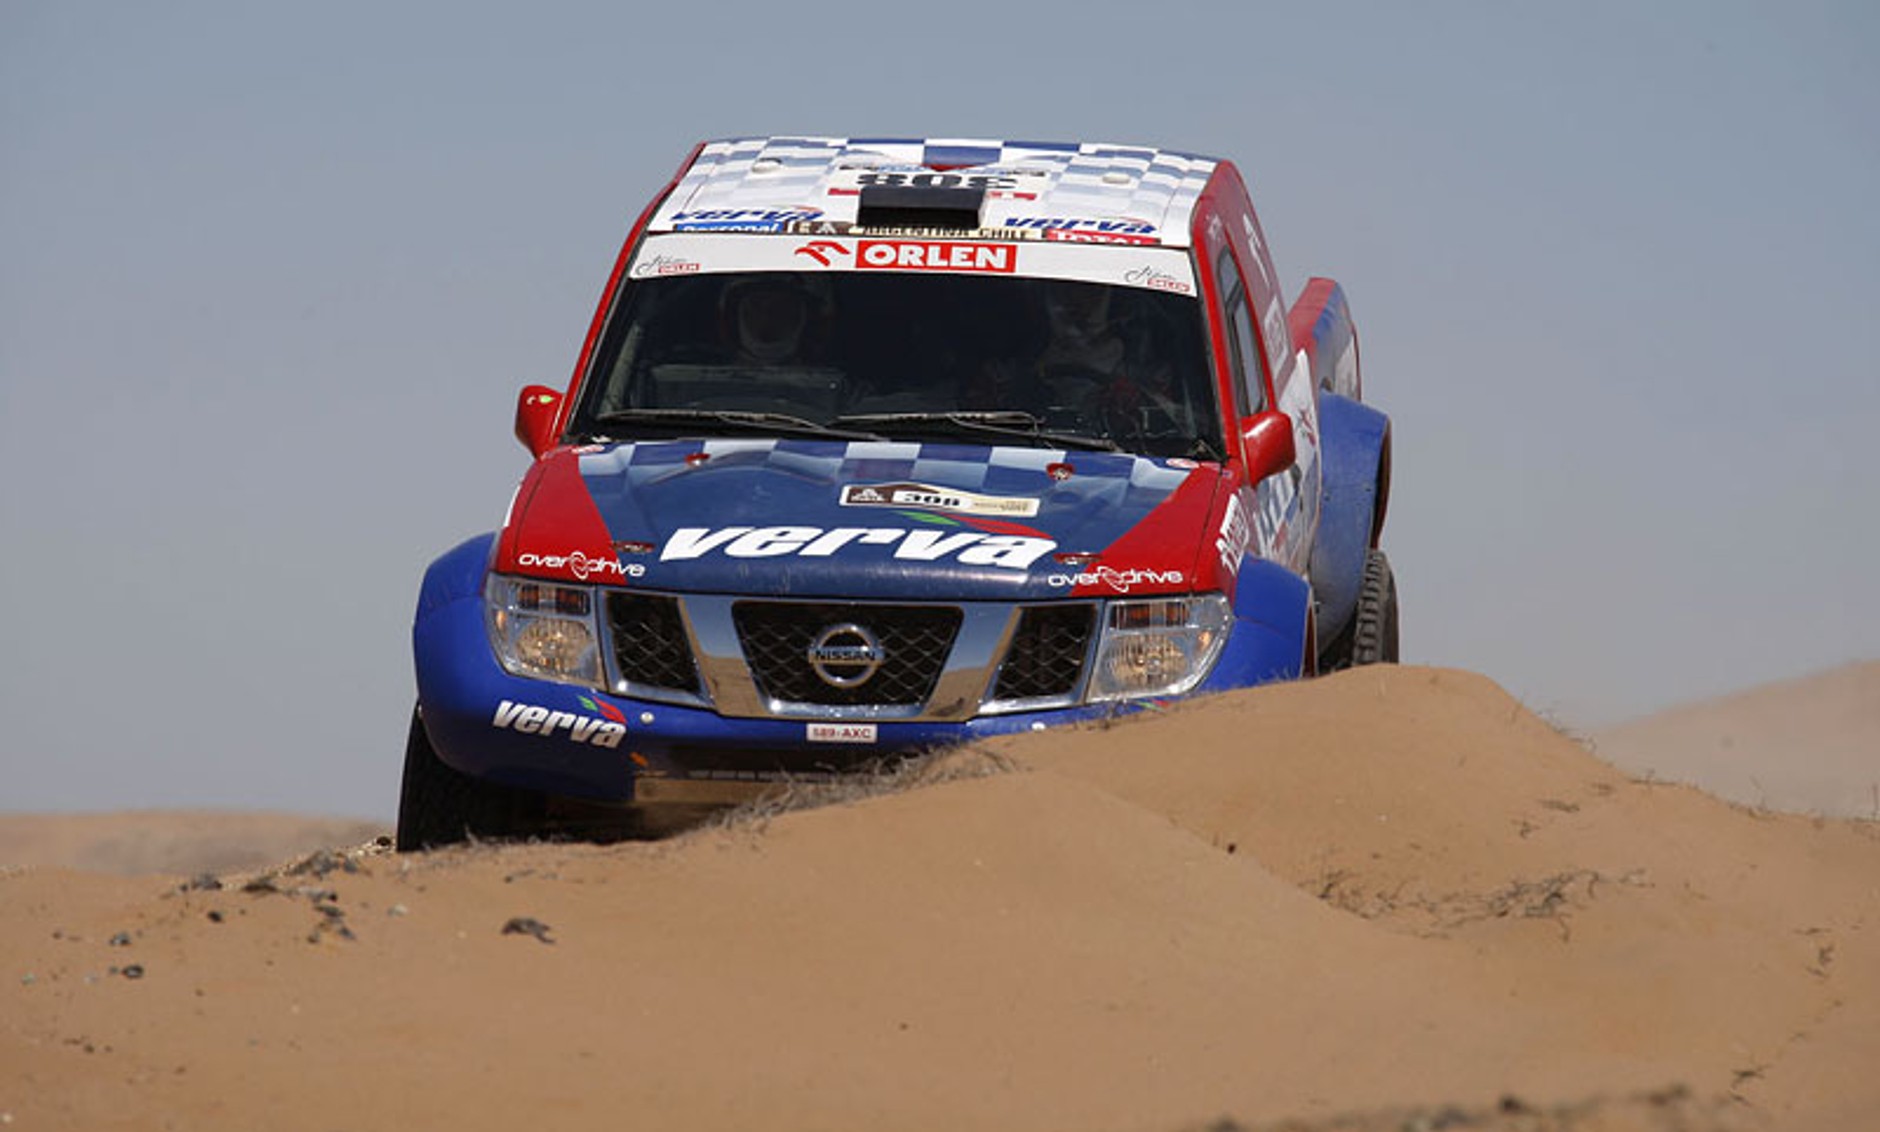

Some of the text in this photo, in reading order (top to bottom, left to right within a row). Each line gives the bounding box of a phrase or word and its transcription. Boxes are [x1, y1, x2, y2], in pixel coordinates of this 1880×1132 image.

[669, 210, 824, 222] verva
[1004, 217, 1157, 234] verva
[863, 243, 1008, 270] ORLEN
[903, 492, 961, 507] 308
[658, 525, 1058, 570] verva
[815, 649, 877, 661] NISSAN
[492, 699, 628, 749] verva
